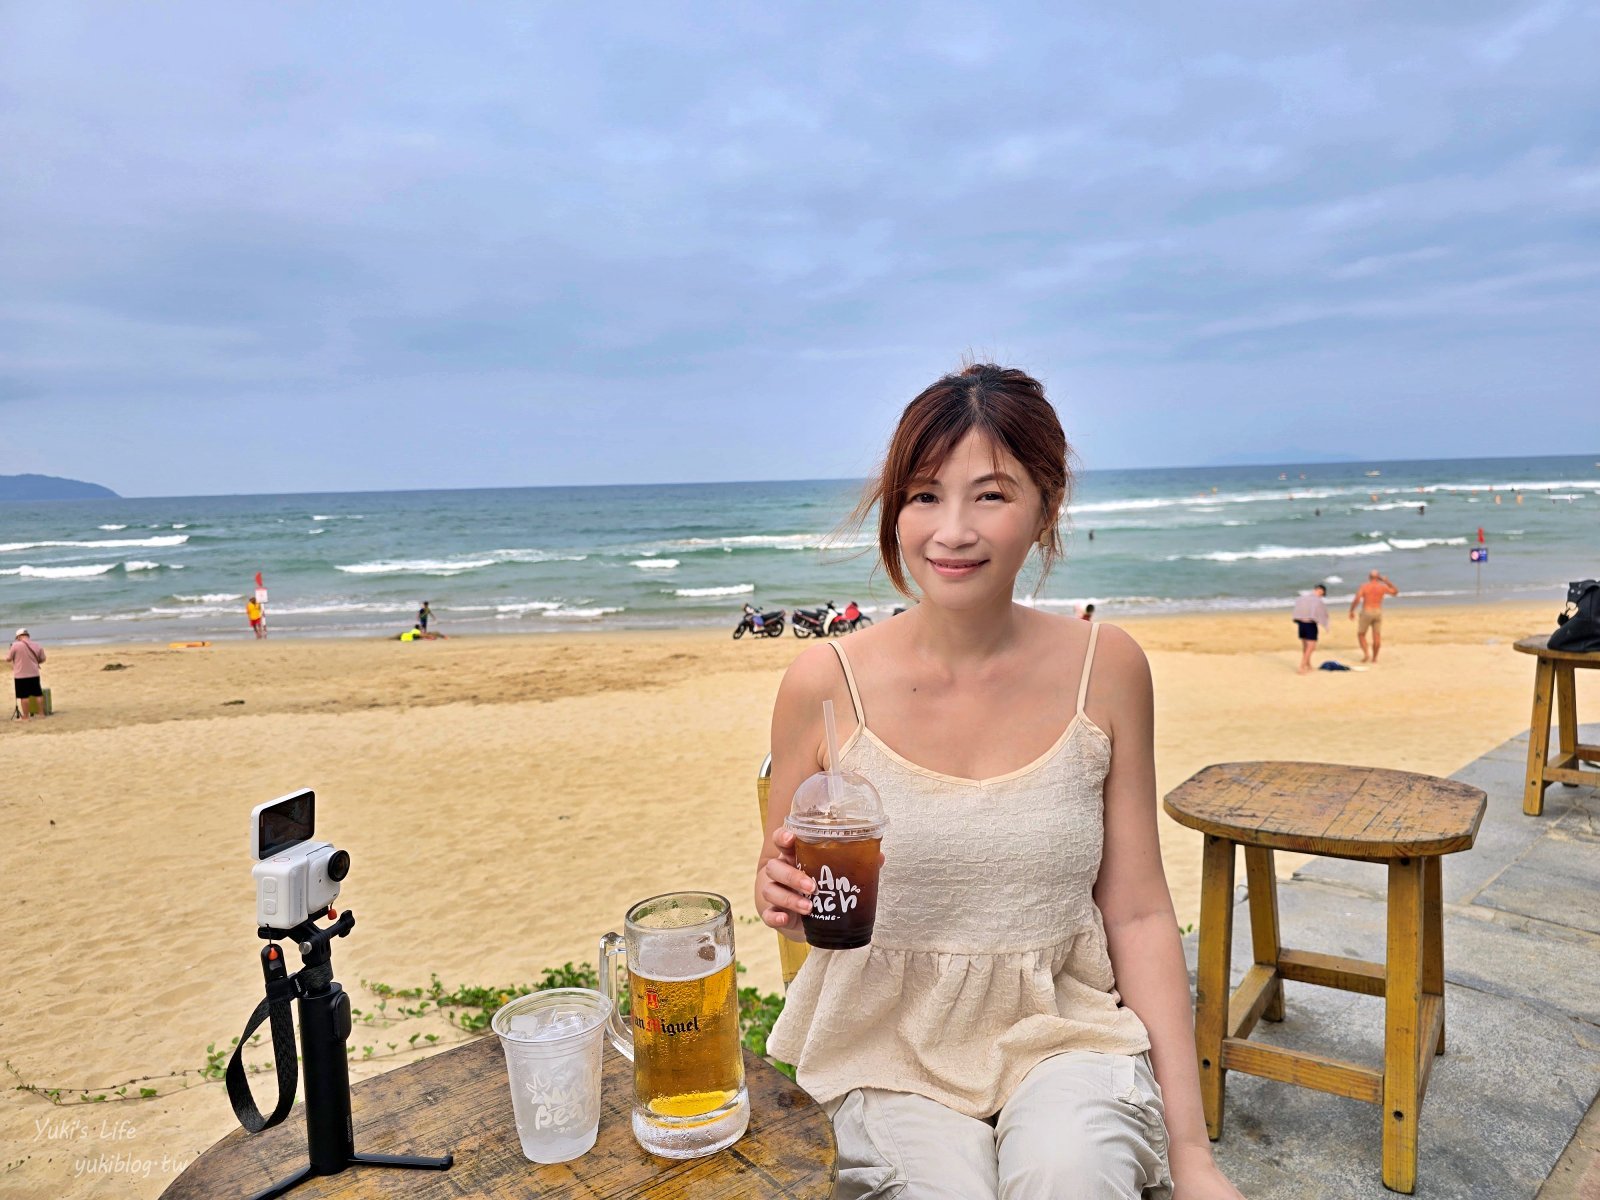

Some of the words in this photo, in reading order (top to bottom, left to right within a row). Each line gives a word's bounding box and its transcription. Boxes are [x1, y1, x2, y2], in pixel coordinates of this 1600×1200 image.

[818, 865, 850, 892] An
[812, 890, 857, 913] ach
[630, 1012, 645, 1030] an
[646, 1015, 701, 1036] Miguel
